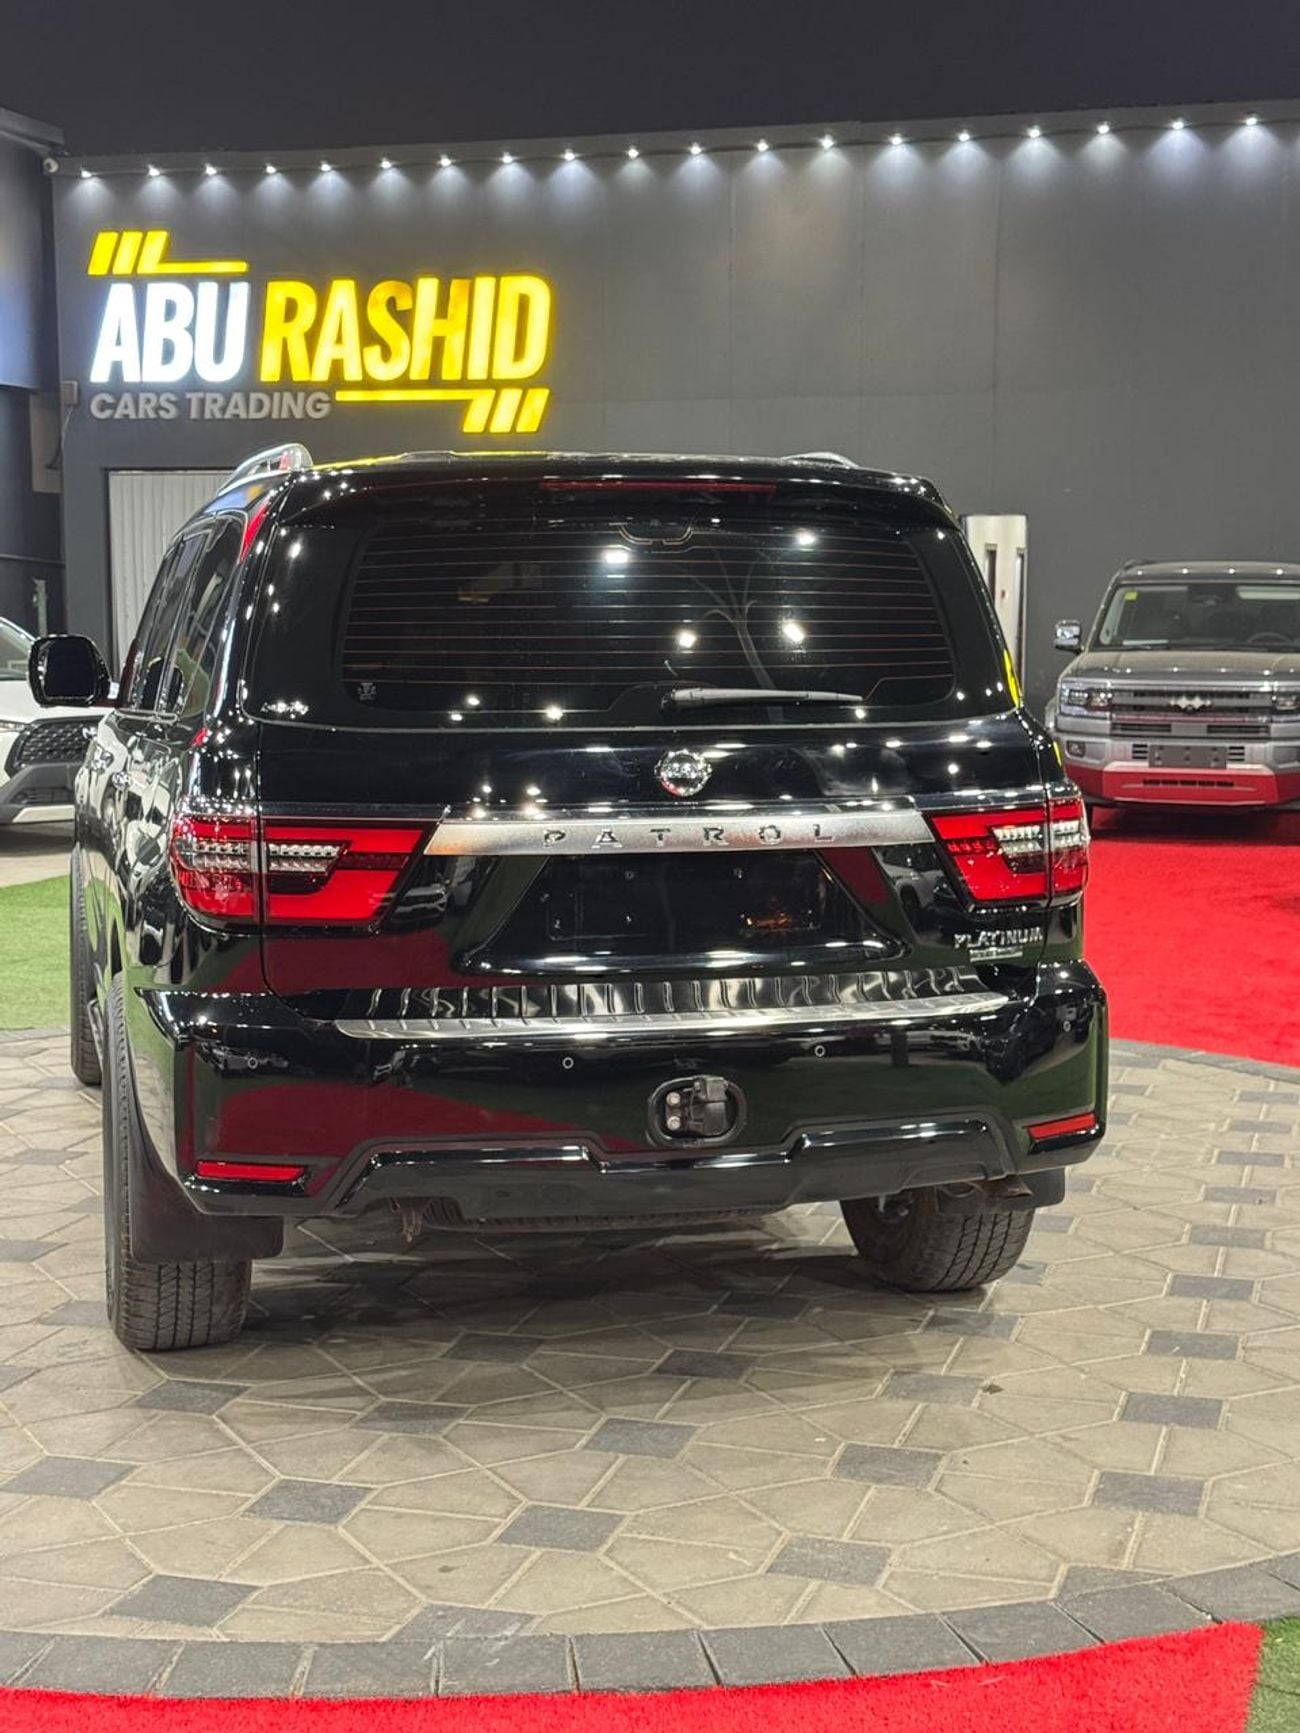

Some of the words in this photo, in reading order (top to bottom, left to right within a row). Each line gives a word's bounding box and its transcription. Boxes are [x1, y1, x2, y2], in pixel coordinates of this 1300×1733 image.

[89, 280, 250, 383] ABU
[260, 275, 551, 382] RASHID
[90, 391, 179, 420] CARS
[186, 390, 332, 420] TRADING
[543, 823, 835, 848] PATROL
[953, 926, 1043, 949] PLATINUM
